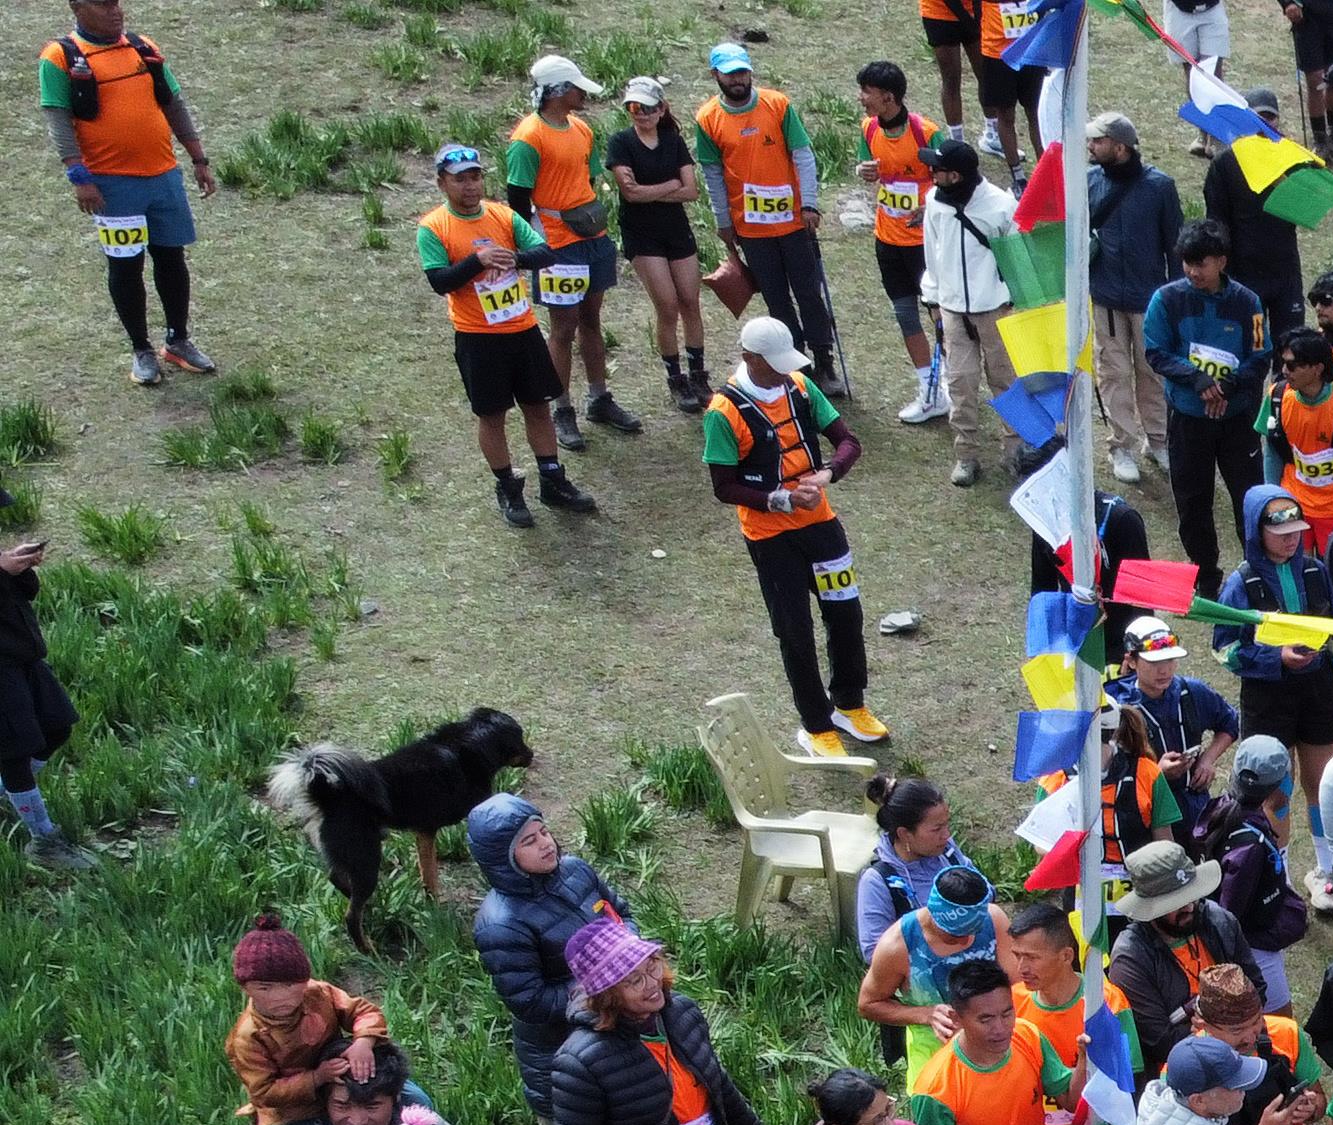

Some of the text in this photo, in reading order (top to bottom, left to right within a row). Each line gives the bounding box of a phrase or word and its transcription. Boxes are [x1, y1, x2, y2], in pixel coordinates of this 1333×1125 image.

[749, 197, 789, 213] 156
[880, 189, 913, 210] 210
[102, 228, 144, 245] 102
[545, 278, 585, 293] 169
[486, 284, 520, 311] 147
